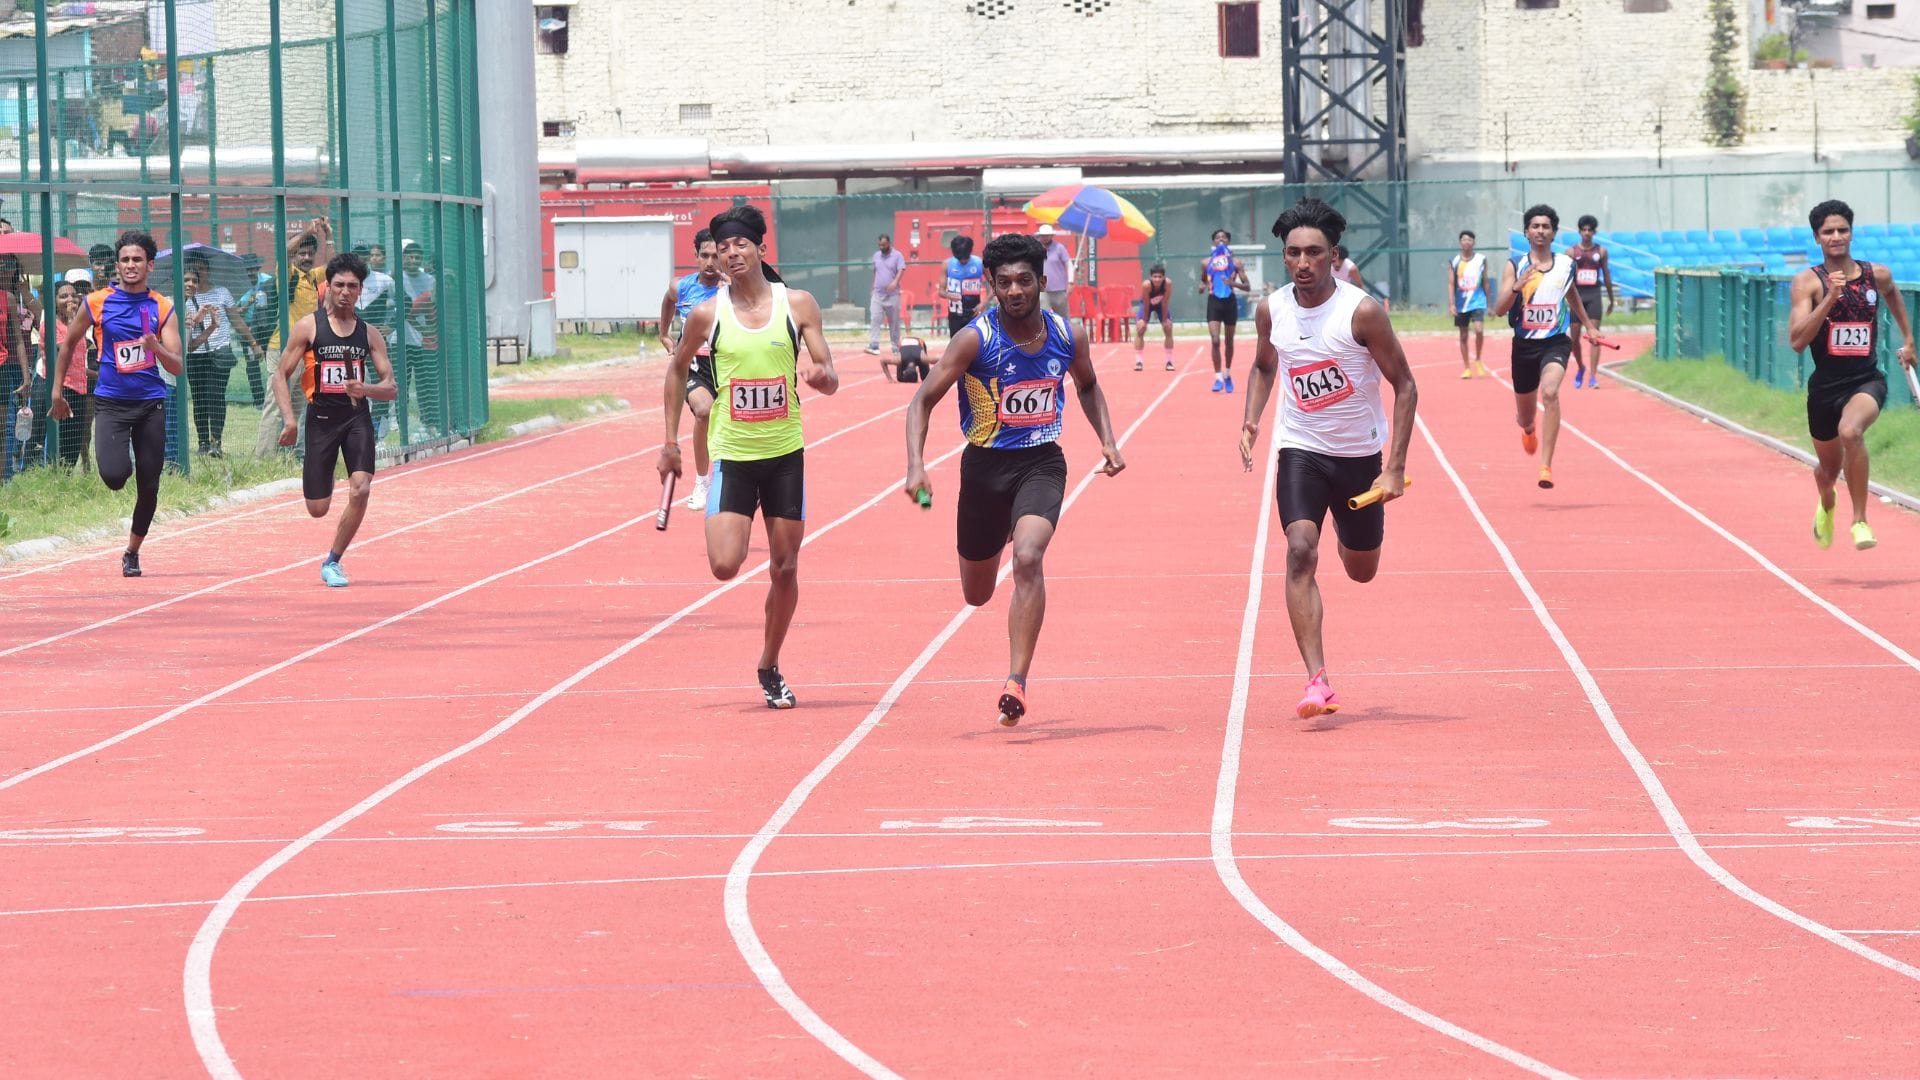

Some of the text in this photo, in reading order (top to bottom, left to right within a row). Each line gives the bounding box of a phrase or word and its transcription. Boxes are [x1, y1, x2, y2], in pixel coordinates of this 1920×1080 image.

[1527, 309, 1553, 323] 202
[1834, 328, 1868, 346] 1232
[120, 346, 141, 363] 97
[318, 345, 366, 357] CHINMAYA
[326, 367, 358, 384] 131
[1295, 366, 1344, 400] 2643
[735, 384, 784, 409] 3114
[1006, 387, 1053, 414] 667
